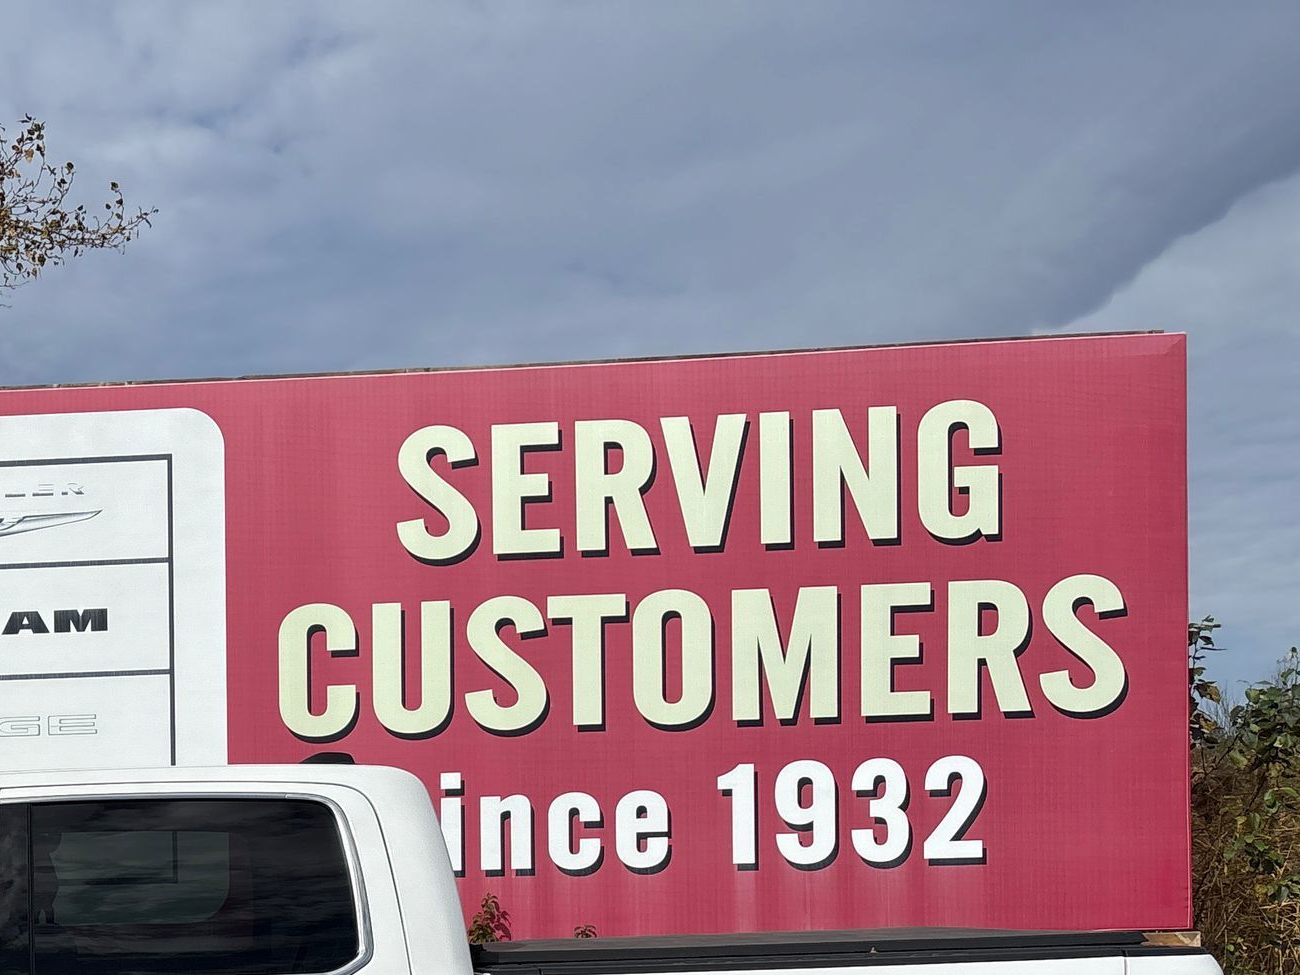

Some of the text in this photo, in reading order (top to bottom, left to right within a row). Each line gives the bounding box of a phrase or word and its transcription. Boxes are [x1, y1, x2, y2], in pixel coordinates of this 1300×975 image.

[395, 399, 1004, 565] SERVING
[276, 573, 1129, 740] CUSTOMERS
[438, 754, 989, 878] ince 1932
